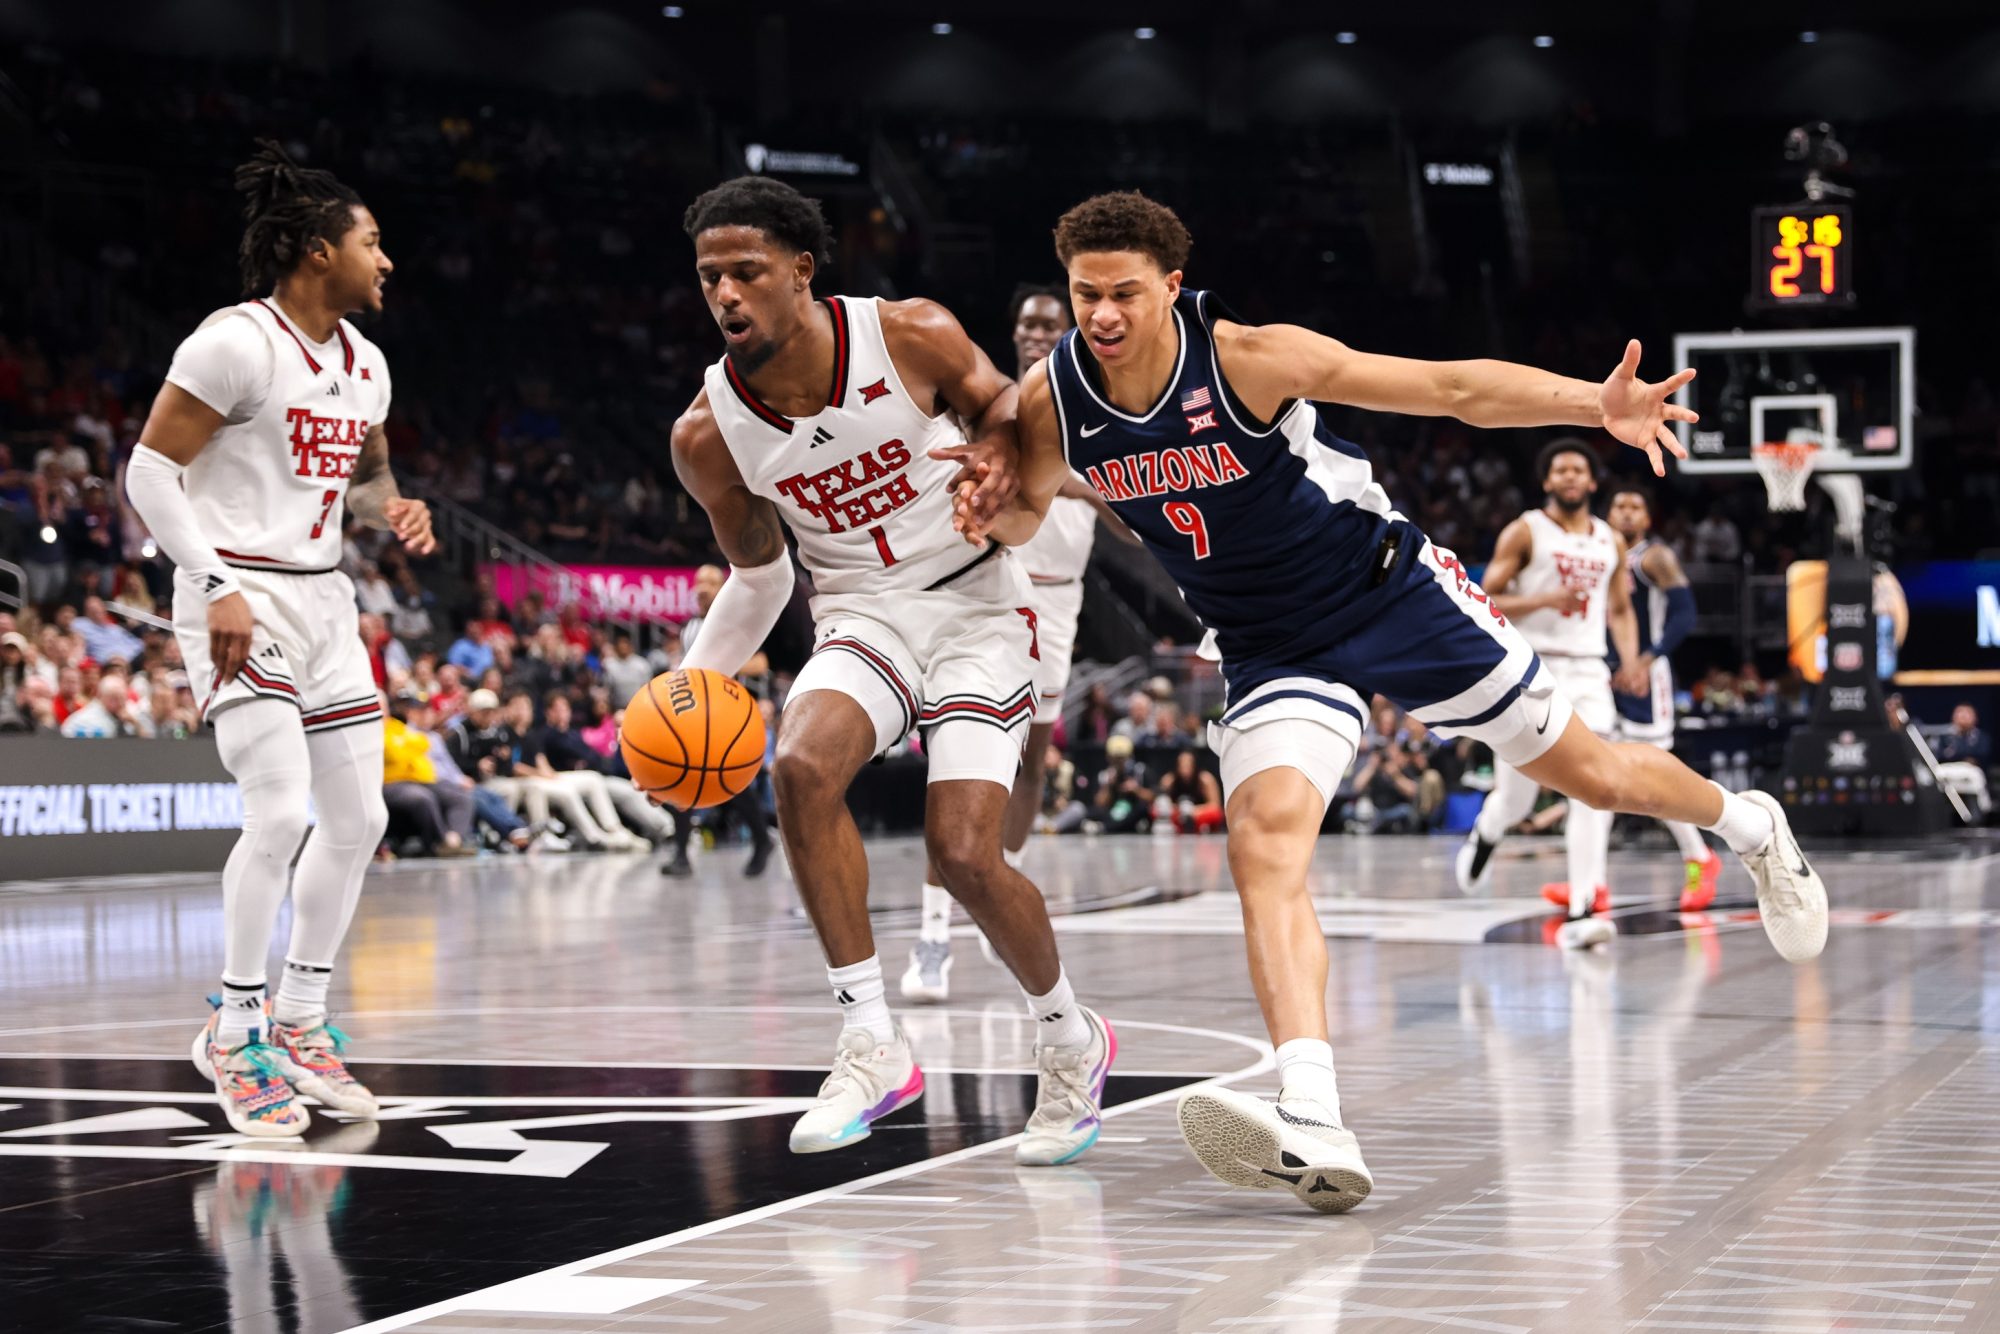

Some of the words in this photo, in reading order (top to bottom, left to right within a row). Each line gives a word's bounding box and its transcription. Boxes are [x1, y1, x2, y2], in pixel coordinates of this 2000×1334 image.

[1770, 245, 1834, 298] 27
[286, 408, 369, 446] TEXAS
[775, 438, 912, 510] TEXAS
[1085, 442, 1250, 502] ARIZONA
[808, 472, 919, 534] TECH
[1162, 501, 1211, 561] 9
[868, 525, 900, 568] 1
[87, 783, 173, 833] TICKET
